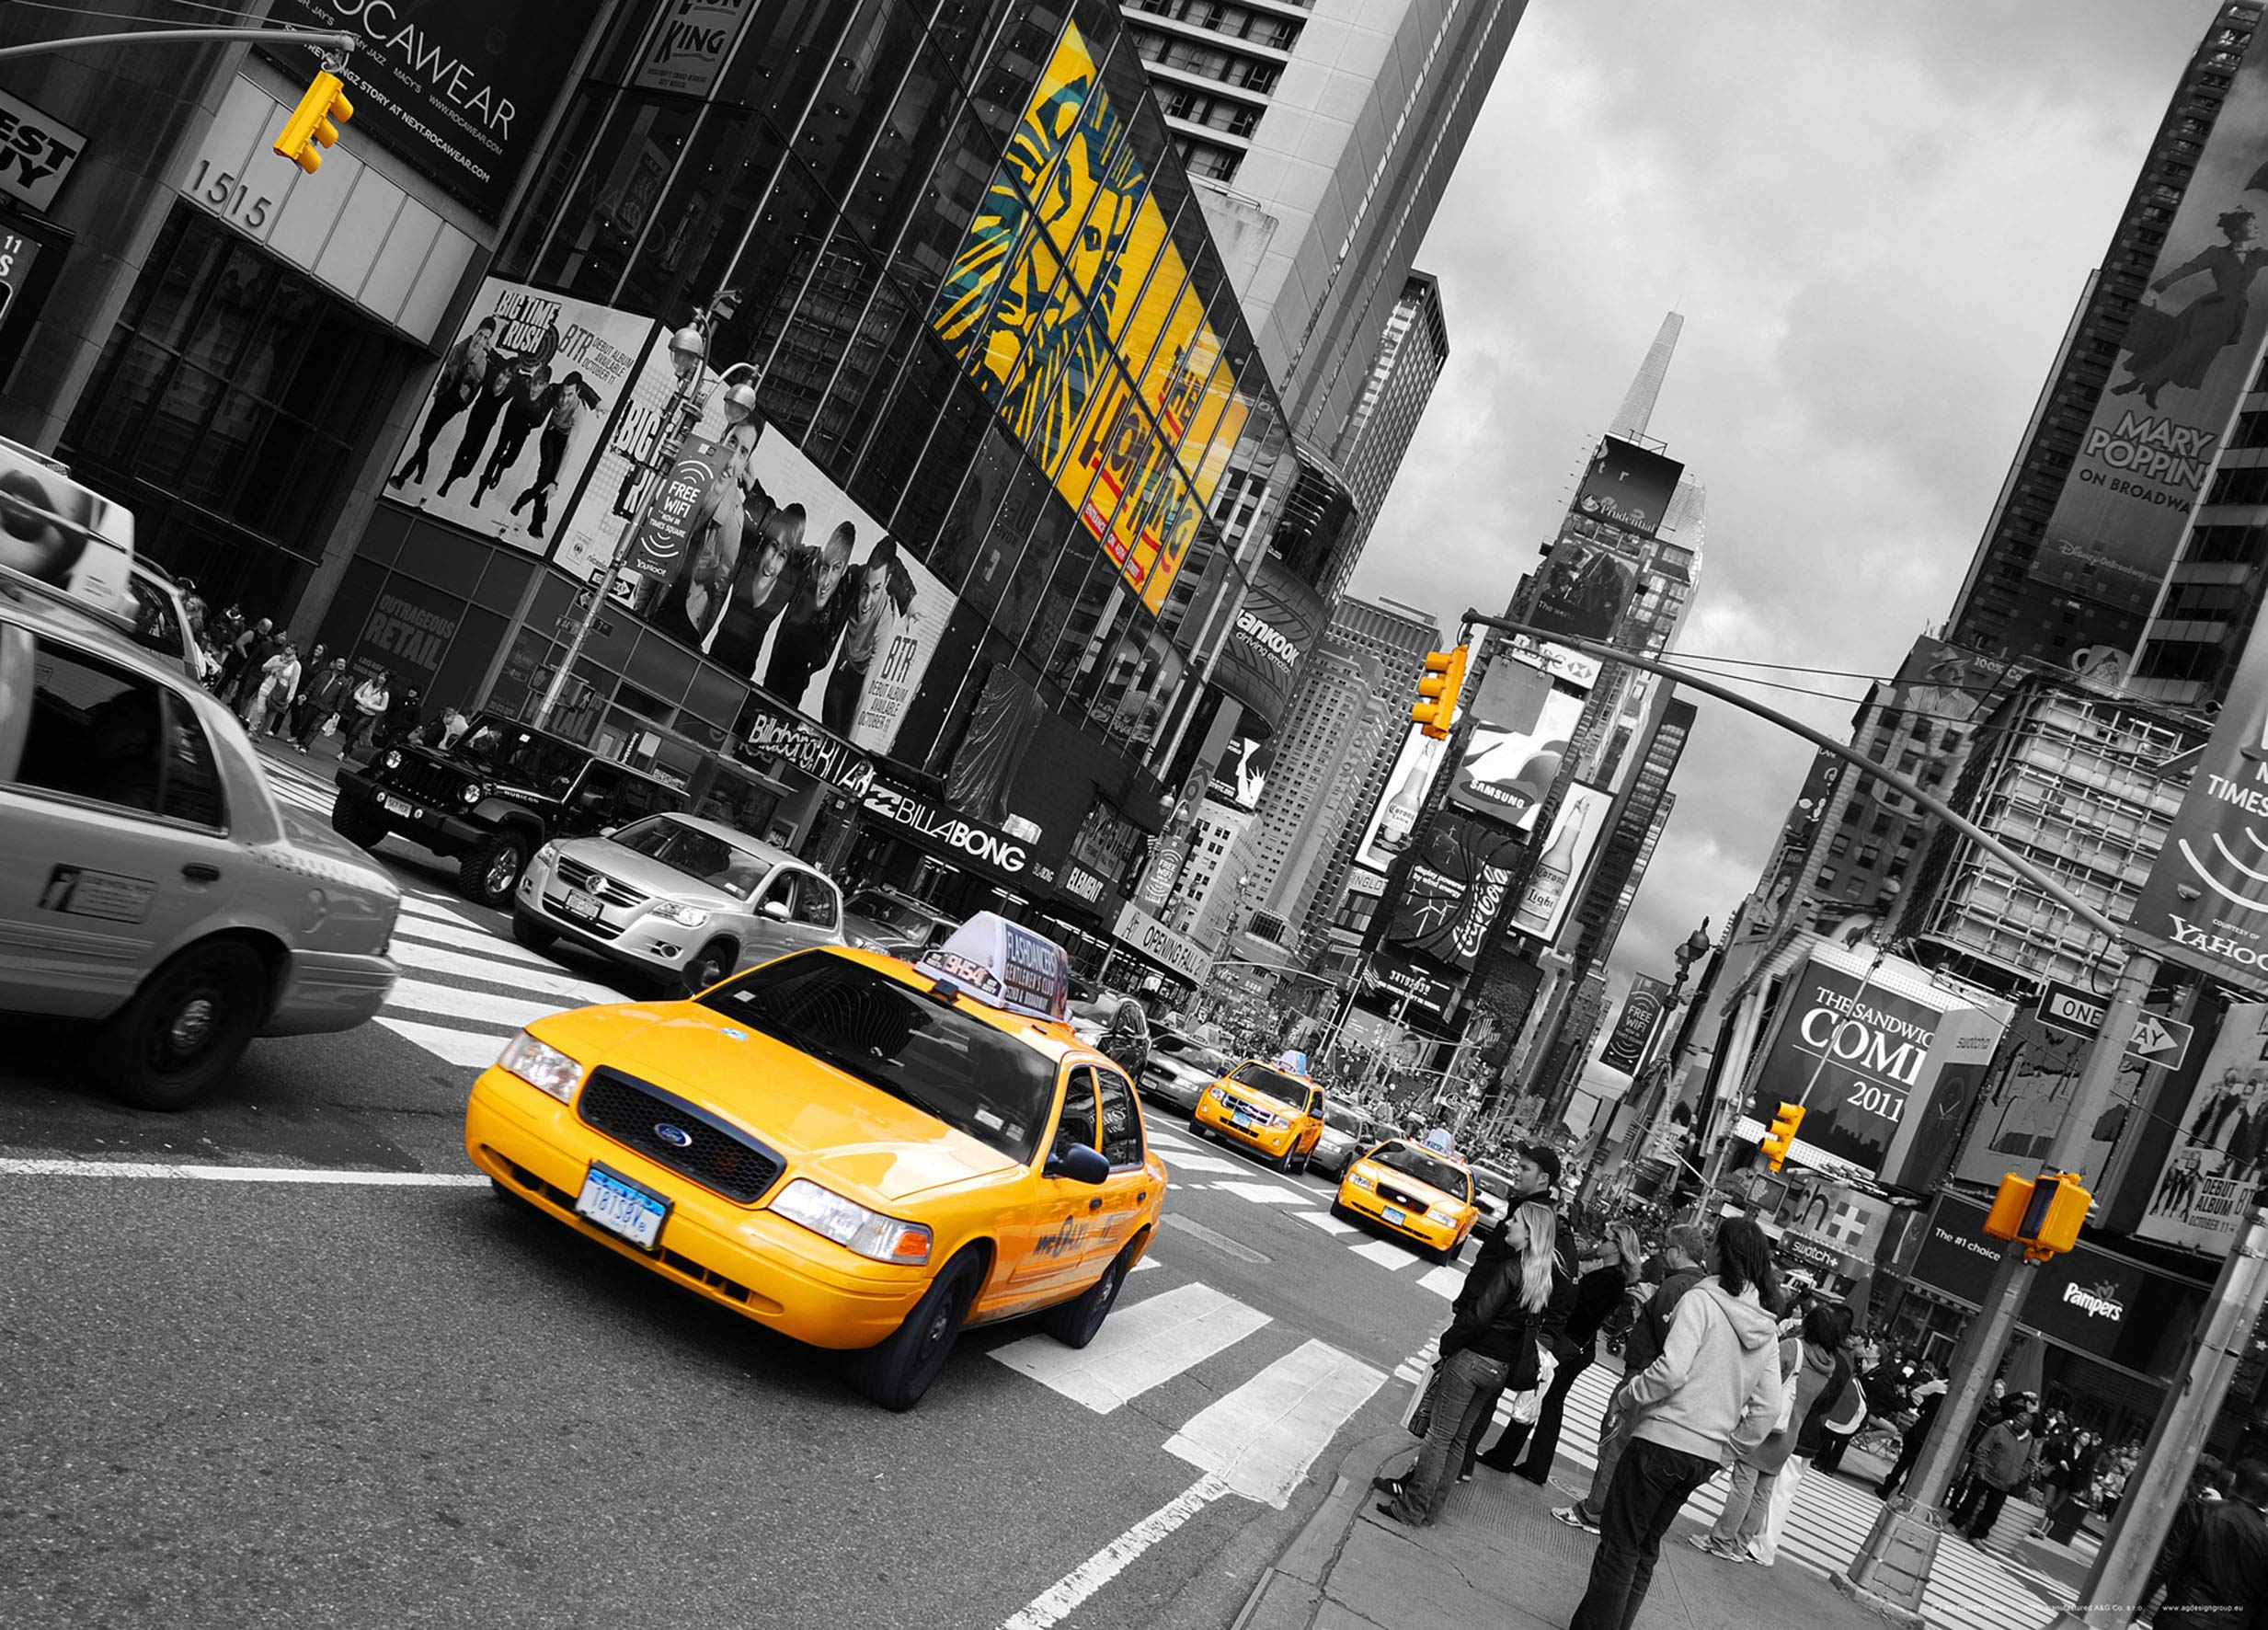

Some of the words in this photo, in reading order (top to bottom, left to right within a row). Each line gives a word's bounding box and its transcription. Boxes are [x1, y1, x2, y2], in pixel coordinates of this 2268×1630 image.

[311, 5, 335, 26] JAY'S
[653, 19, 727, 63] KING
[304, 44, 327, 61] REY
[360, 81, 390, 110] STORY
[389, 103, 402, 120] AT
[401, 111, 490, 183] NEXT.ROCAWEAR.COM
[366, 48, 386, 66] JAZZ
[393, 67, 422, 93] MACY'S
[429, 94, 503, 155] WWW.ROCAWEAR.COM
[191, 159, 272, 227] 1515
[494, 290, 526, 321] BIG
[520, 295, 562, 330] TIME
[501, 320, 546, 354] RUSH
[557, 323, 595, 363] BTR
[591, 337, 615, 360] DEBUT
[611, 348, 635, 369] ALBUM
[594, 352, 625, 378] AVAILABLE
[581, 357, 609, 381] OCTOBER
[2114, 409, 2218, 459] MARY
[669, 480, 701, 504] FREE
[2079, 467, 2107, 487] ON
[2110, 477, 2196, 515] BROADWA
[663, 496, 692, 519] WIFI
[1599, 503, 1656, 534] Prudential
[378, 594, 456, 639] OUTRAGEOUS
[363, 612, 443, 672] RETAIL
[1235, 631, 1268, 656] driving
[880, 635, 918, 683] BTR
[1974, 656, 2005, 676] 100%
[1469, 779, 1526, 809] SAMSUNG
[1389, 803, 1415, 821] Corona
[895, 797, 1026, 873] BILLABONG
[1158, 857, 1178, 872] FREE
[1414, 864, 1437, 880] display
[1437, 875, 1467, 891] powered
[1065, 867, 1104, 904] ELEMENT
[1422, 876, 1439, 889] wind
[1438, 884, 1461, 899] energy
[1528, 889, 1554, 909] Light
[1142, 925, 1183, 964] OPENING
[2212, 918, 2250, 936] COURTESY
[2249, 931, 2262, 942] OF
[944, 954, 987, 984] 9H54
[1627, 1004, 1654, 1024] FREE
[1816, 986, 1852, 1014] THE
[1625, 1016, 1647, 1033] WIFI
[2062, 1000, 2104, 1027] ONE
[2134, 1026, 2166, 1047] AY
[1847, 1081, 1905, 1123] 2011
[2194, 1197, 2235, 1218] ALBUM
[2202, 1177, 2239, 1200] DEBUT
[2235, 1187, 2256, 1218] BT
[2188, 1214, 2219, 1234] OCTOBER
[1935, 1226, 1953, 1243] The
[1954, 1235, 1967, 1247] #1
[1967, 1242, 2001, 1263] choice
[2062, 1281, 2124, 1322] Pampers
